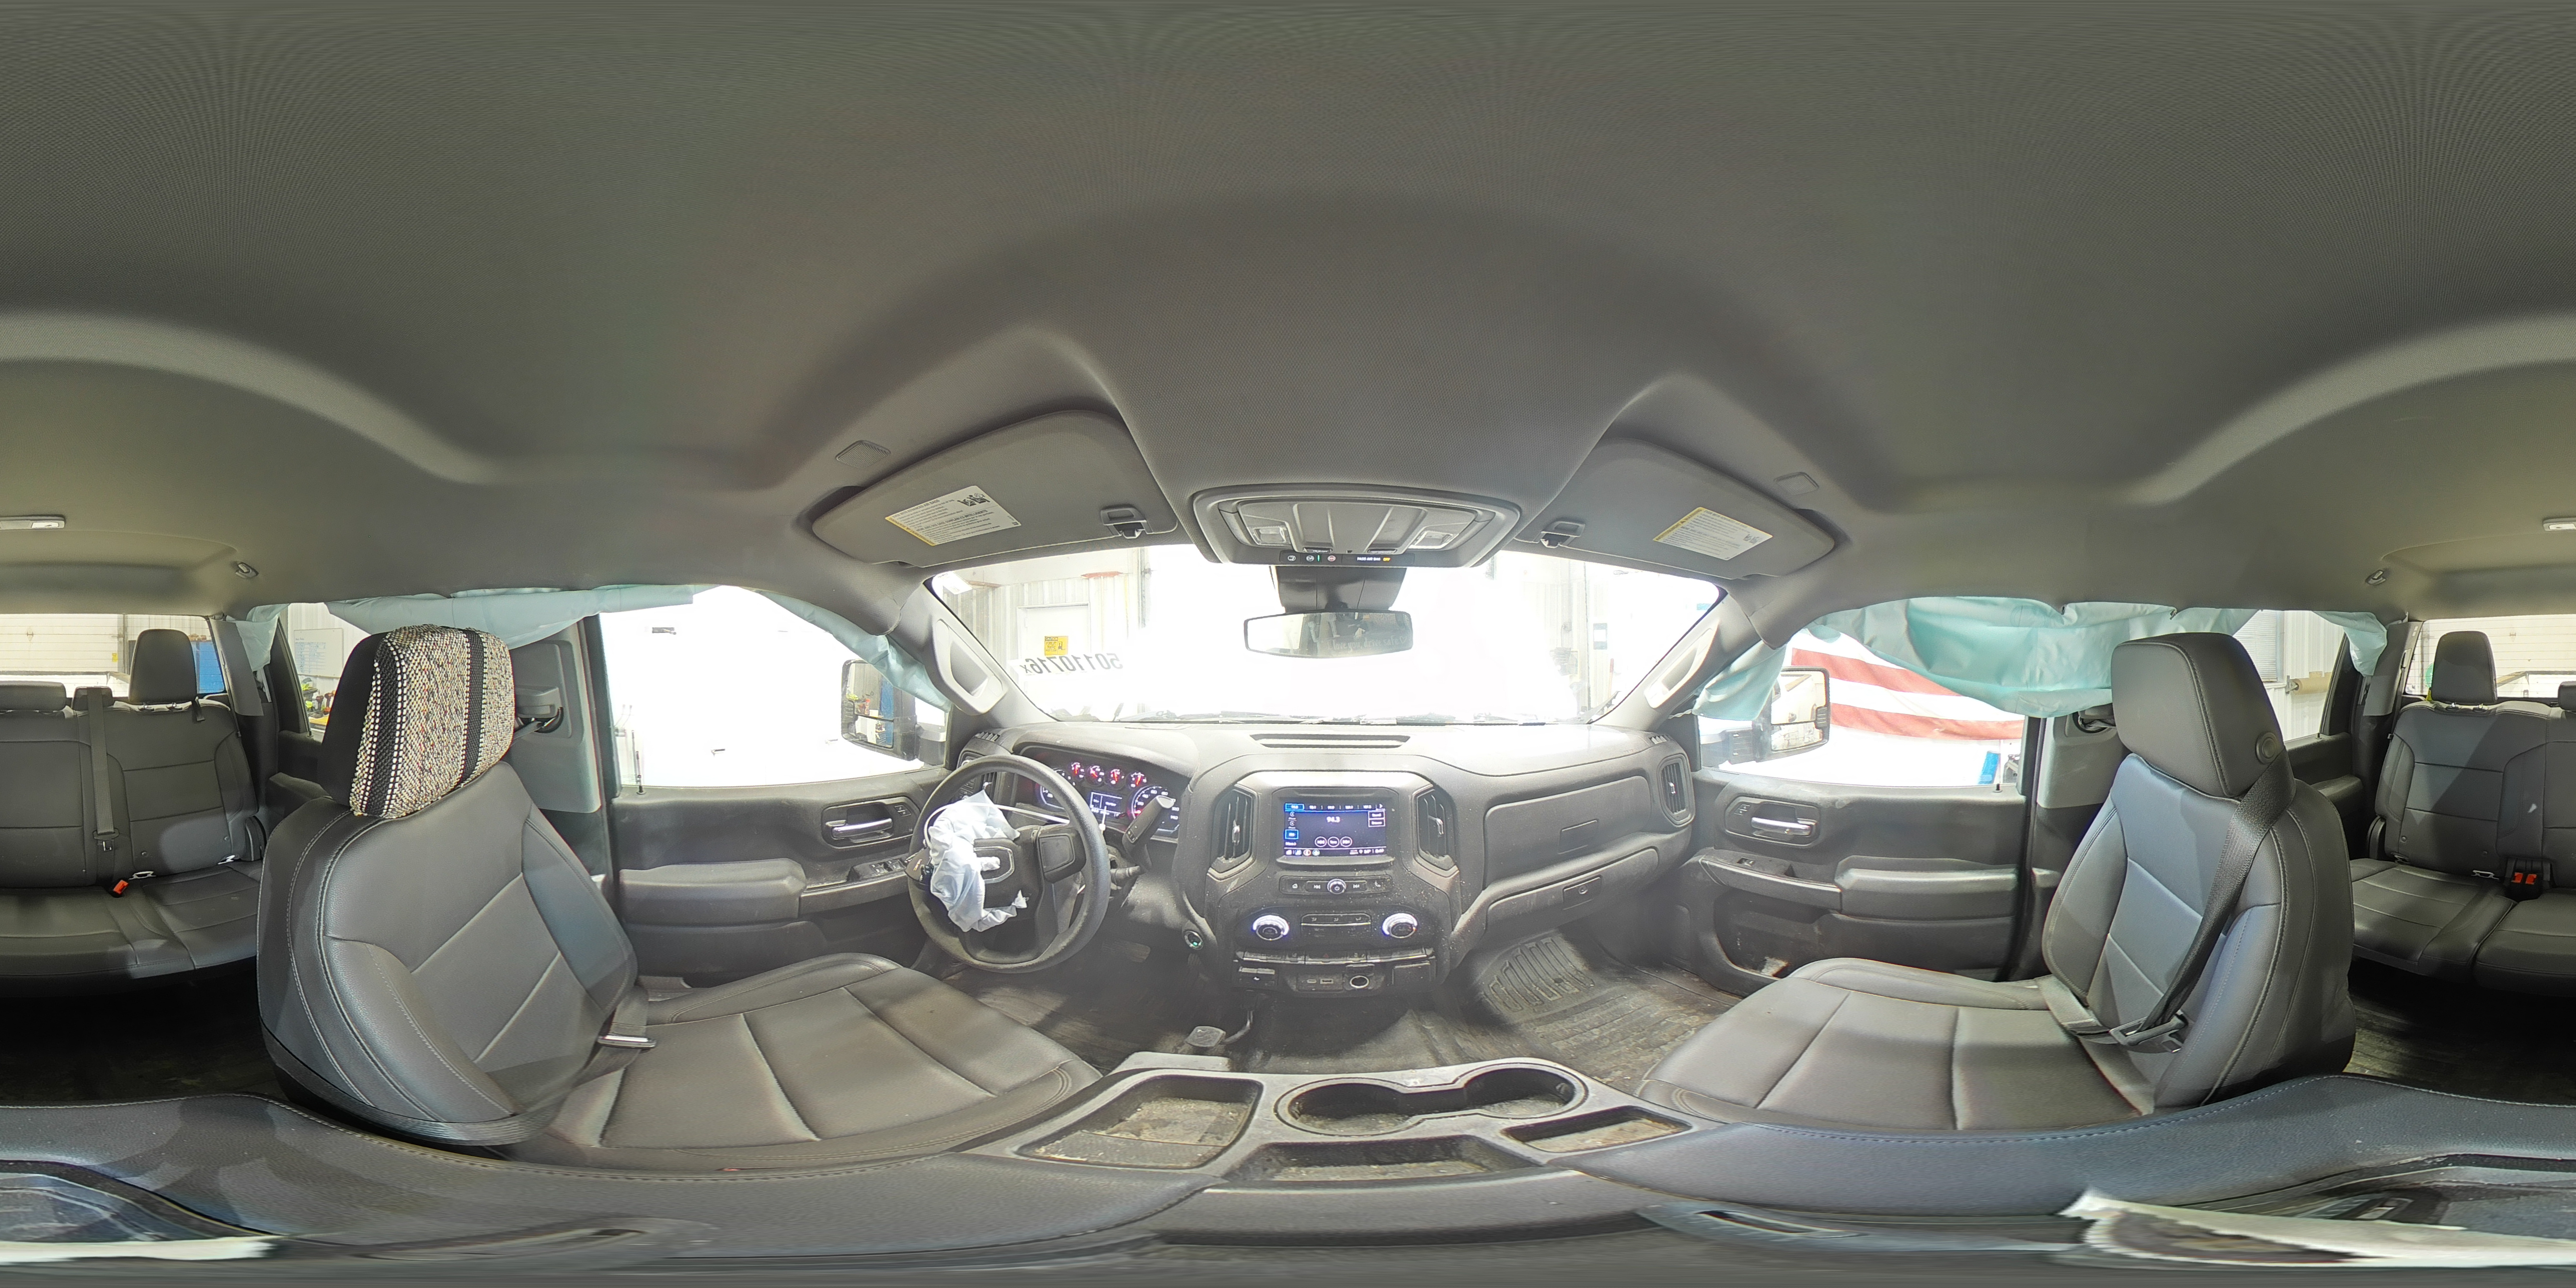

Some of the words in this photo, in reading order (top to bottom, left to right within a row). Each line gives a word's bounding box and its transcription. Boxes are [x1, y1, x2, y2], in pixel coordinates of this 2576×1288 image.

[1333, 639, 1347, 650] love
[1348, 642, 1363, 653] you,
[1364, 637, 1381, 647] drive
[1383, 635, 1399, 646] safe
